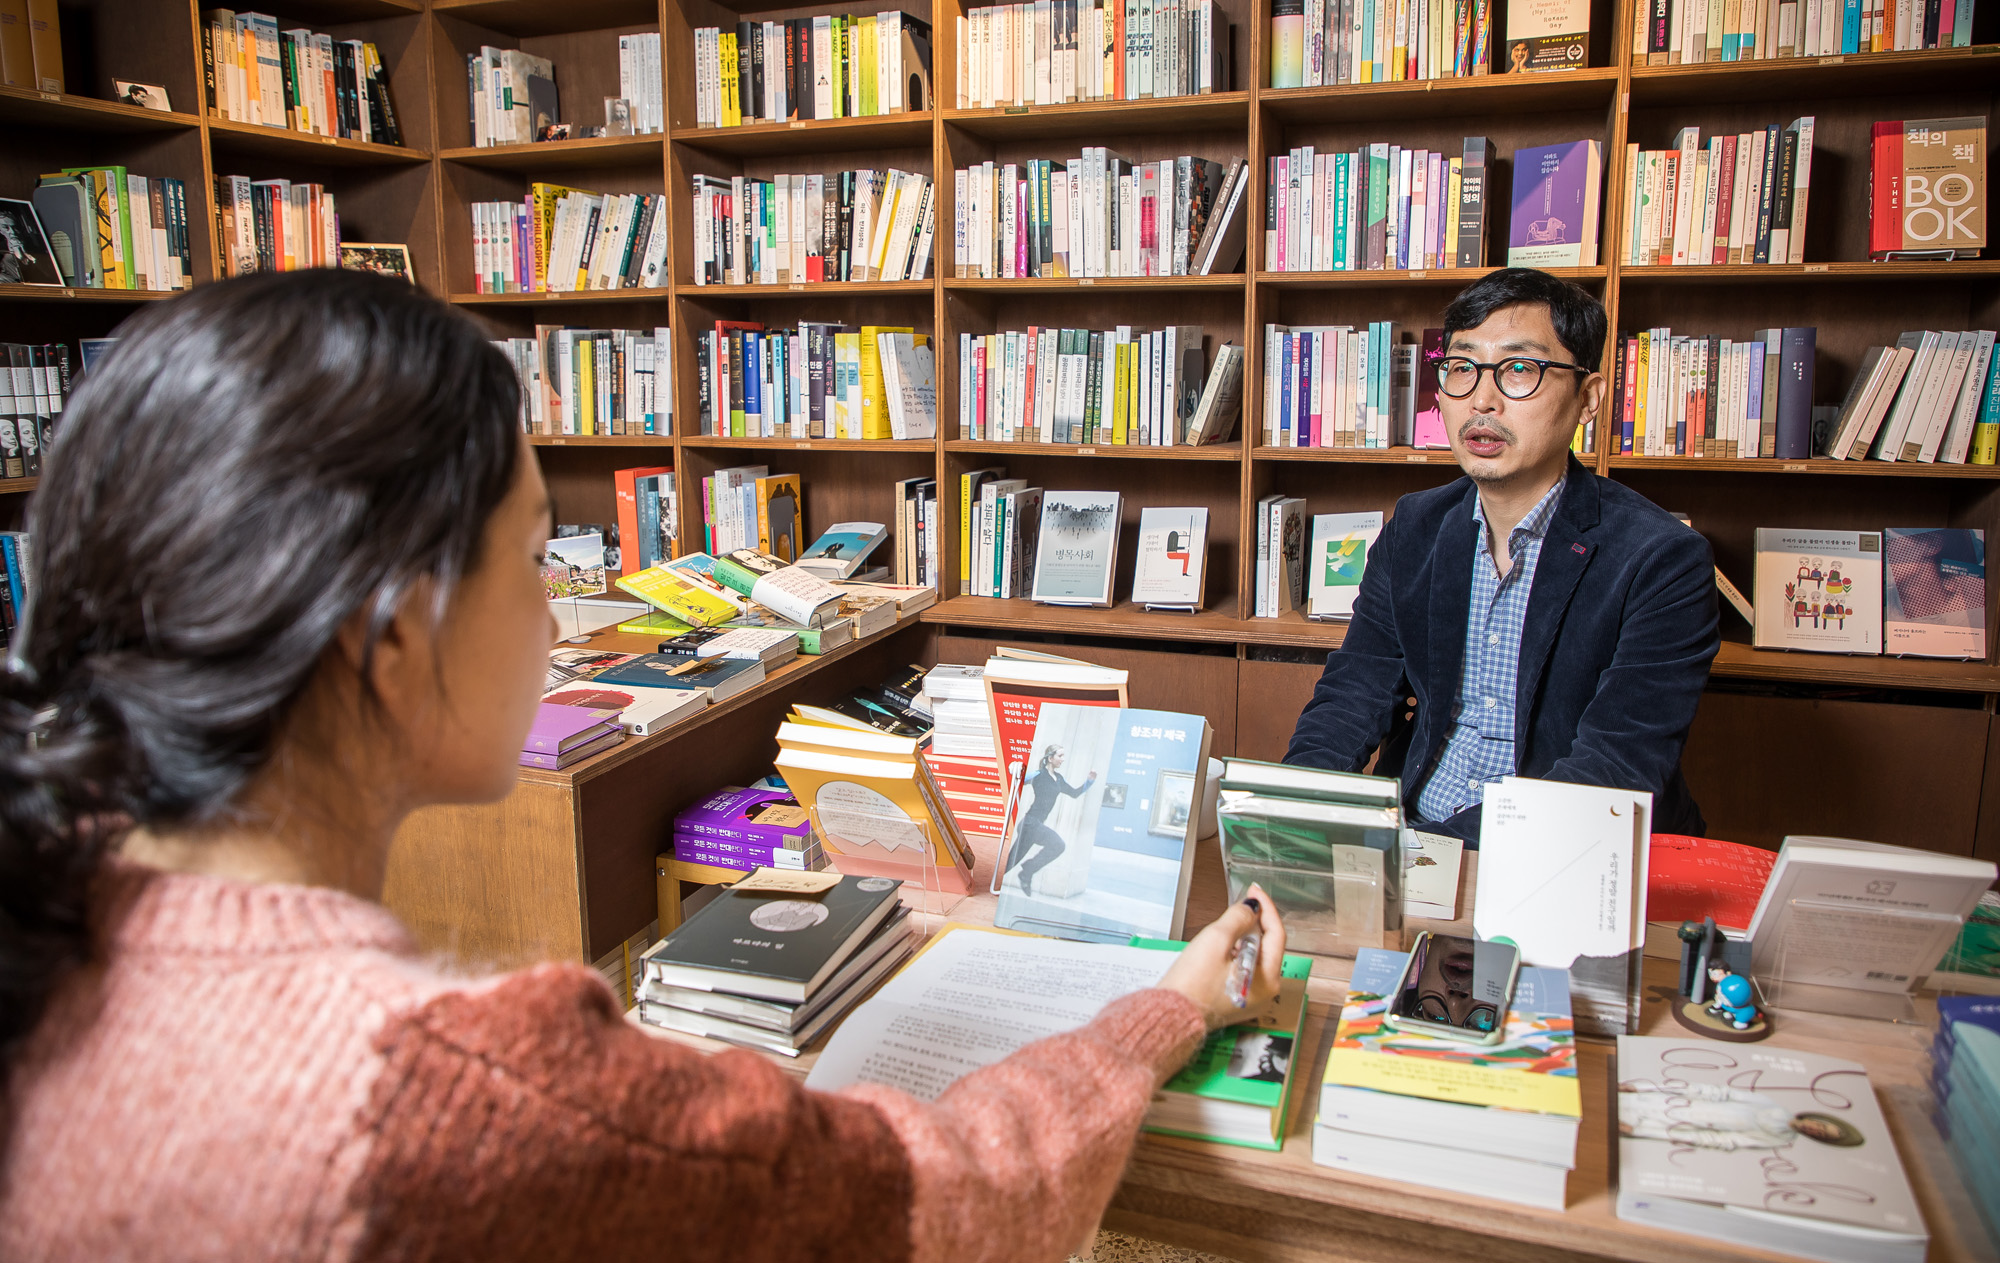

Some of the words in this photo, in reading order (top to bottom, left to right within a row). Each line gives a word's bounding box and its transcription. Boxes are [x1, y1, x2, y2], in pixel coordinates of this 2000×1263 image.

[1907, 128, 1947, 147] 책의
[1952, 143, 1974, 163] 책
[1684, 152, 1694, 173] 독서의
[1463, 177, 1481, 185] 차이의
[1683, 174, 1692, 187] 역사
[236, 181, 244, 211] INCOME
[243, 181, 251, 211] BASIC
[1463, 193, 1480, 203] 정의
[534, 217, 543, 274] PHILOSOPHY
[983, 503, 993, 528] 좌파로
[983, 528, 992, 545] 살다
[1055, 549, 1094, 561] 병목사회
[1130, 726, 1163, 740] 창조의
[1163, 729, 1186, 743] 제국
[693, 824, 705, 833] 모든
[706, 826, 718, 835] 것에
[718, 828, 742, 839] 반대한다
[693, 839, 705, 848] 모든
[706, 841, 718, 850] 것에
[719, 843, 743, 853] 반대한다
[695, 852, 707, 861] 모든
[707, 854, 720, 863] 것에
[721, 856, 745, 867] 반대한다
